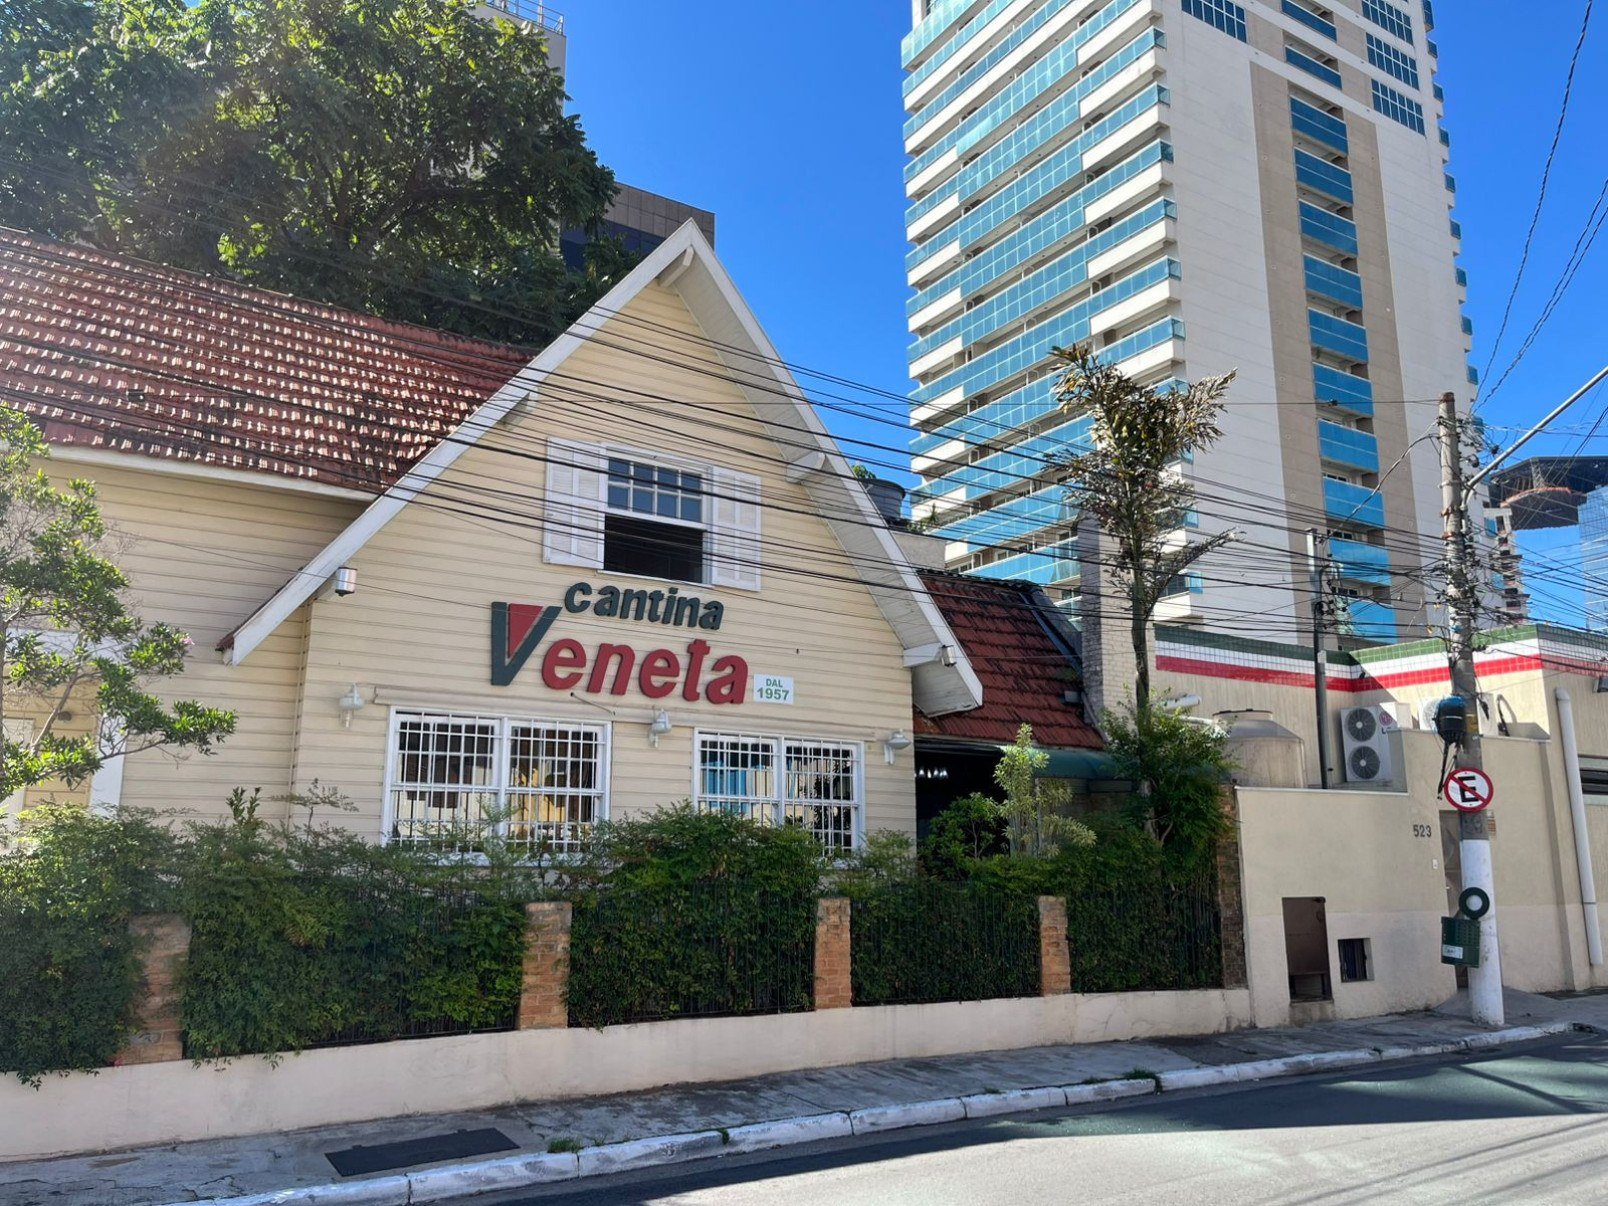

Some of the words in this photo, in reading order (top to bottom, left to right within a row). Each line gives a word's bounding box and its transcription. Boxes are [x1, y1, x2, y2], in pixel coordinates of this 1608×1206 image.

[564, 582, 724, 630] cantina
[491, 601, 749, 704] Veneta
[766, 678, 783, 688] DAL
[757, 687, 789, 700] 1957
[1458, 776, 1479, 802] E
[1413, 824, 1431, 838] 523
